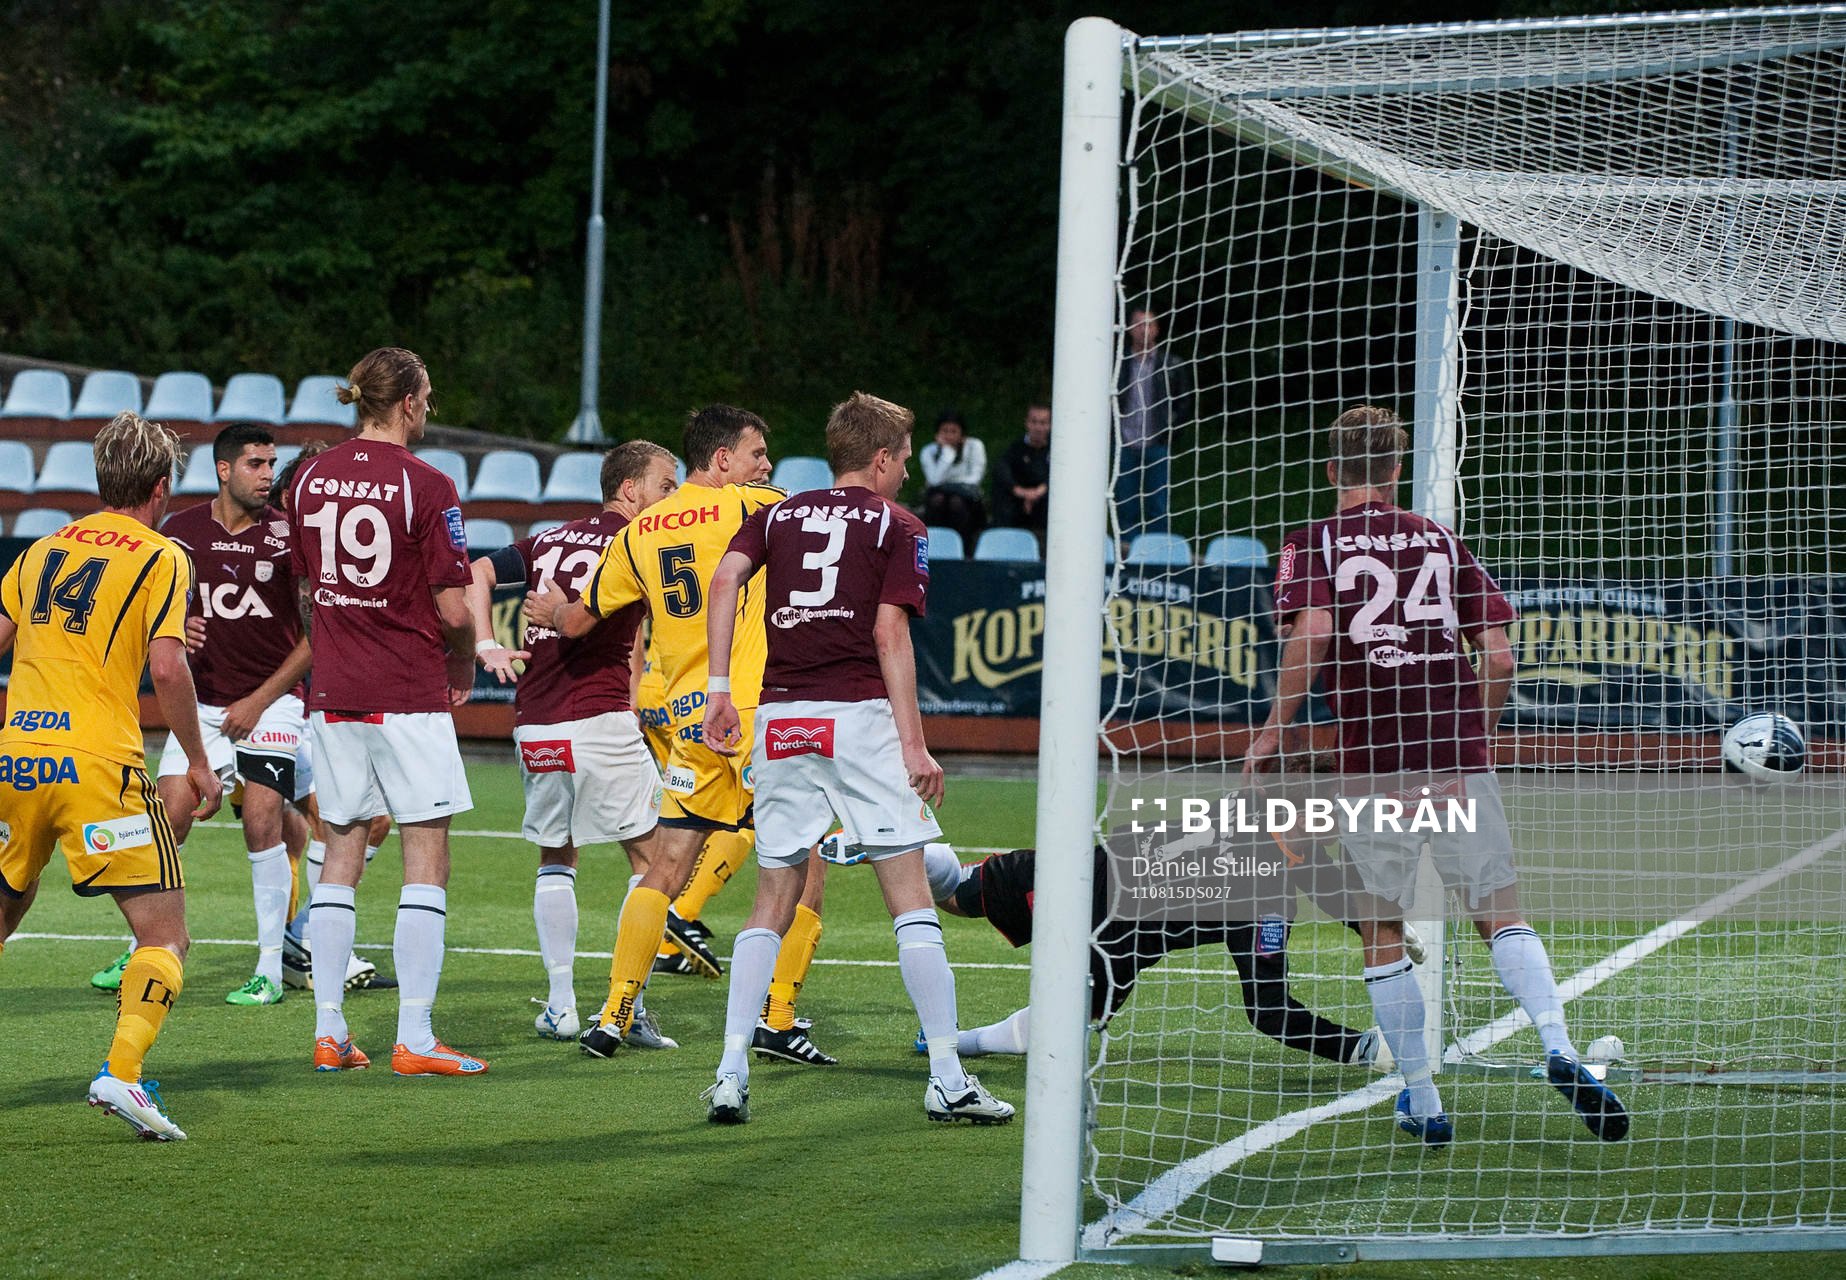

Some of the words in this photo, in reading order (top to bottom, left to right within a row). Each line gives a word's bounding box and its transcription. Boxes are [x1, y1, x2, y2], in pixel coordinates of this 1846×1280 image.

[353, 452, 369, 461] ICA
[308, 477, 399, 502] CONSAT
[638, 505, 719, 536] RICOH
[775, 505, 881, 524] CONSAT
[210, 541, 254, 554] stadium
[263, 536, 286, 550] EDB
[303, 501, 392, 588] 19
[1335, 531, 1440, 552] CONSAT
[789, 515, 848, 607] 3
[321, 572, 336, 580] ICA
[356, 575, 369, 584] ICA
[658, 543, 702, 618] 5
[31, 548, 109, 635] 14
[199, 583, 274, 620] ICA
[1128, 577, 1191, 602] CIDER
[1335, 552, 1459, 645] 24
[951, 598, 1257, 690] KOPRBERG
[672, 691, 708, 718] agD
[251, 731, 299, 745] Canon
[671, 775, 694, 789] Bixia
